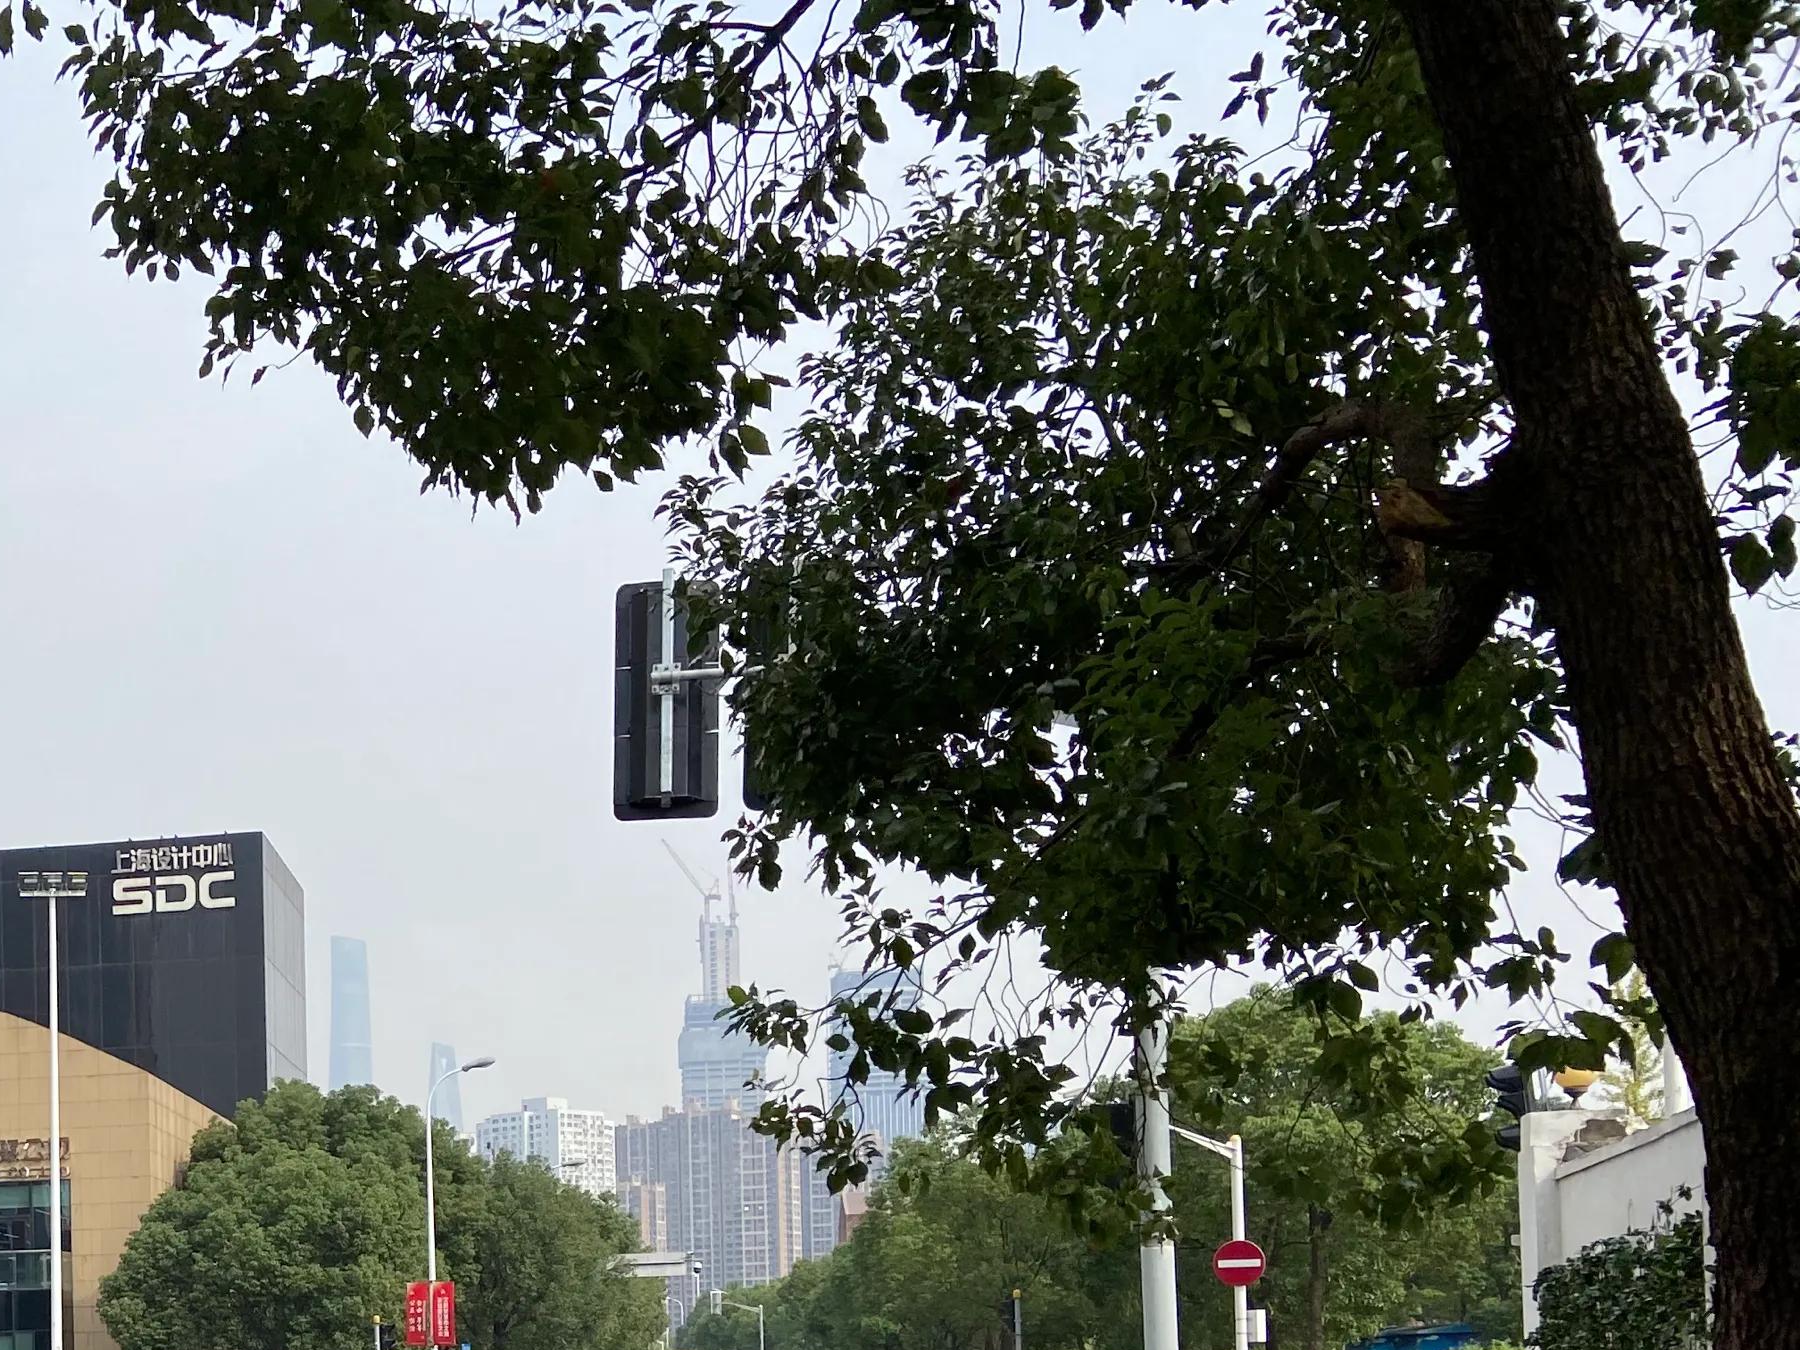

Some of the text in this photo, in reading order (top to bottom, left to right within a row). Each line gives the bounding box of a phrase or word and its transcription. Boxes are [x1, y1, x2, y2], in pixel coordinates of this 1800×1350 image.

[111, 842, 234, 874] 上海设计中心
[112, 870, 236, 915] SDC
